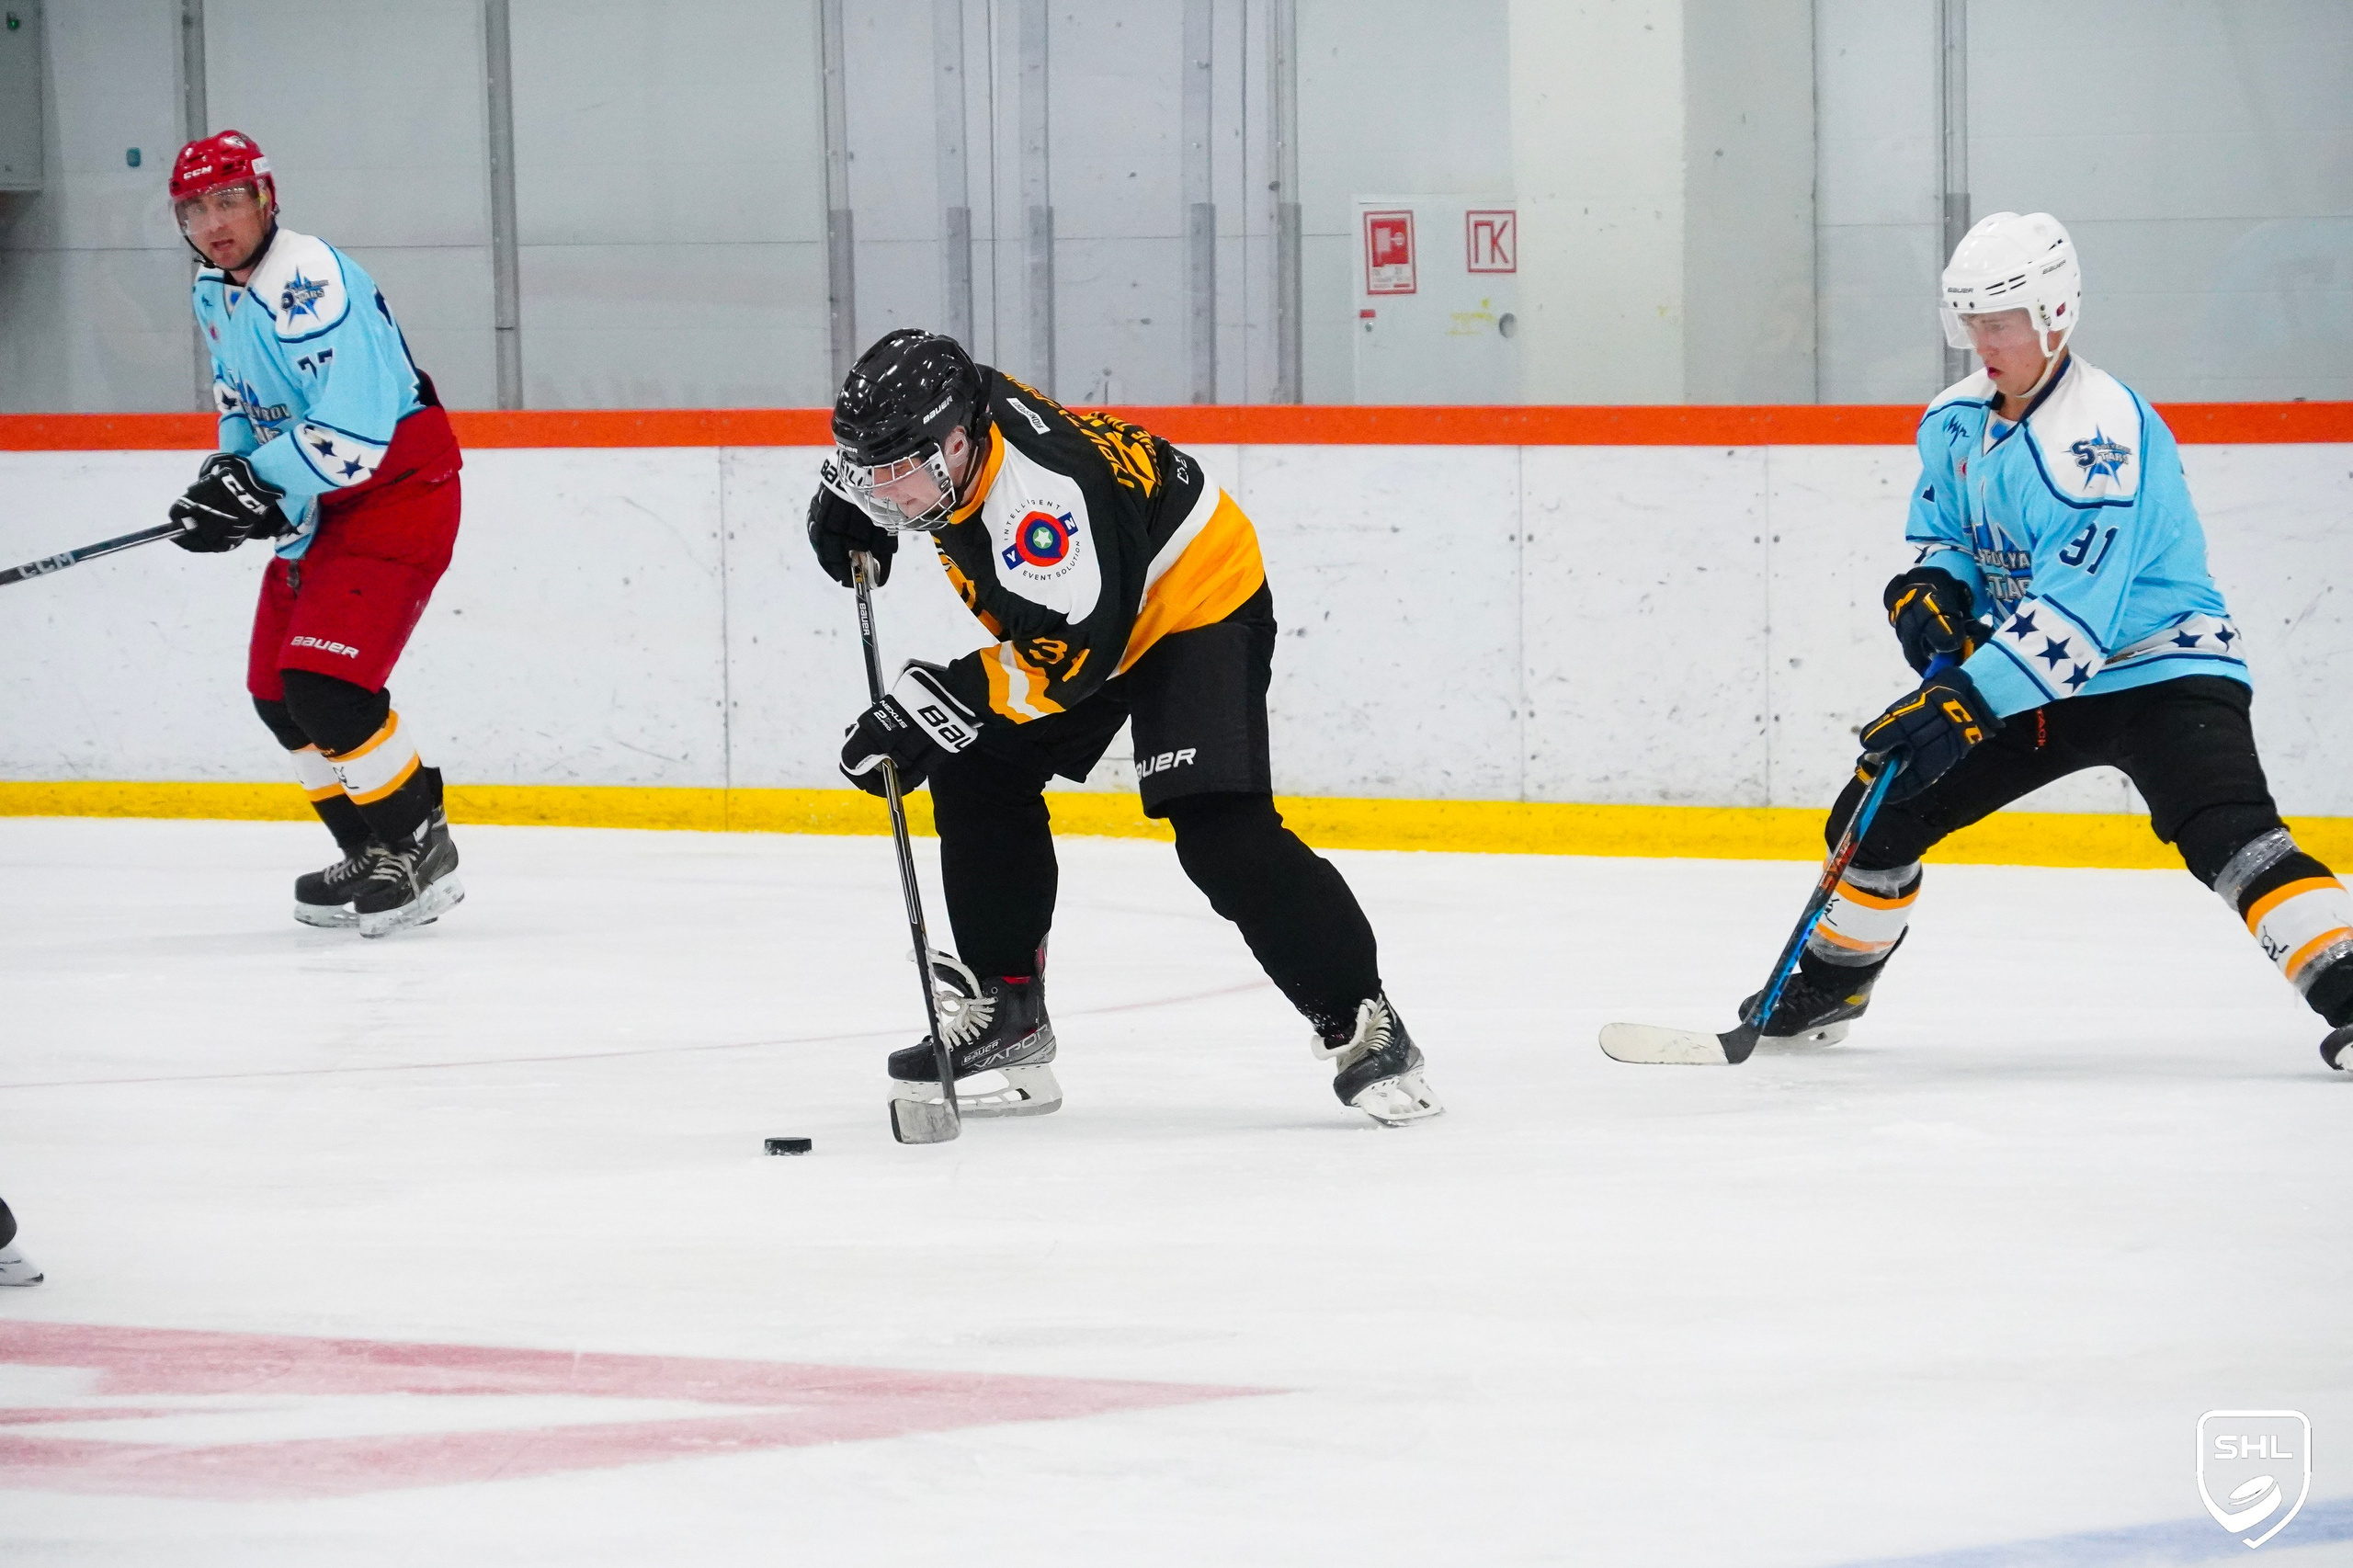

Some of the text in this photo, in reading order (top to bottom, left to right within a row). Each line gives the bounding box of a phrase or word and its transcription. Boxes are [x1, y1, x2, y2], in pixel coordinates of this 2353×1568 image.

[183, 165, 213, 180] CCM
[1473, 220, 1509, 264] ПК
[1004, 499, 1062, 540] INTELLIGENT
[18, 551, 76, 578] CCM
[1022, 540, 1081, 581] EVENT SOLUTION
[2059, 522, 2119, 575] 91
[880, 699, 908, 729] NEXUS
[971, 1024, 1049, 1068] VAPOR
